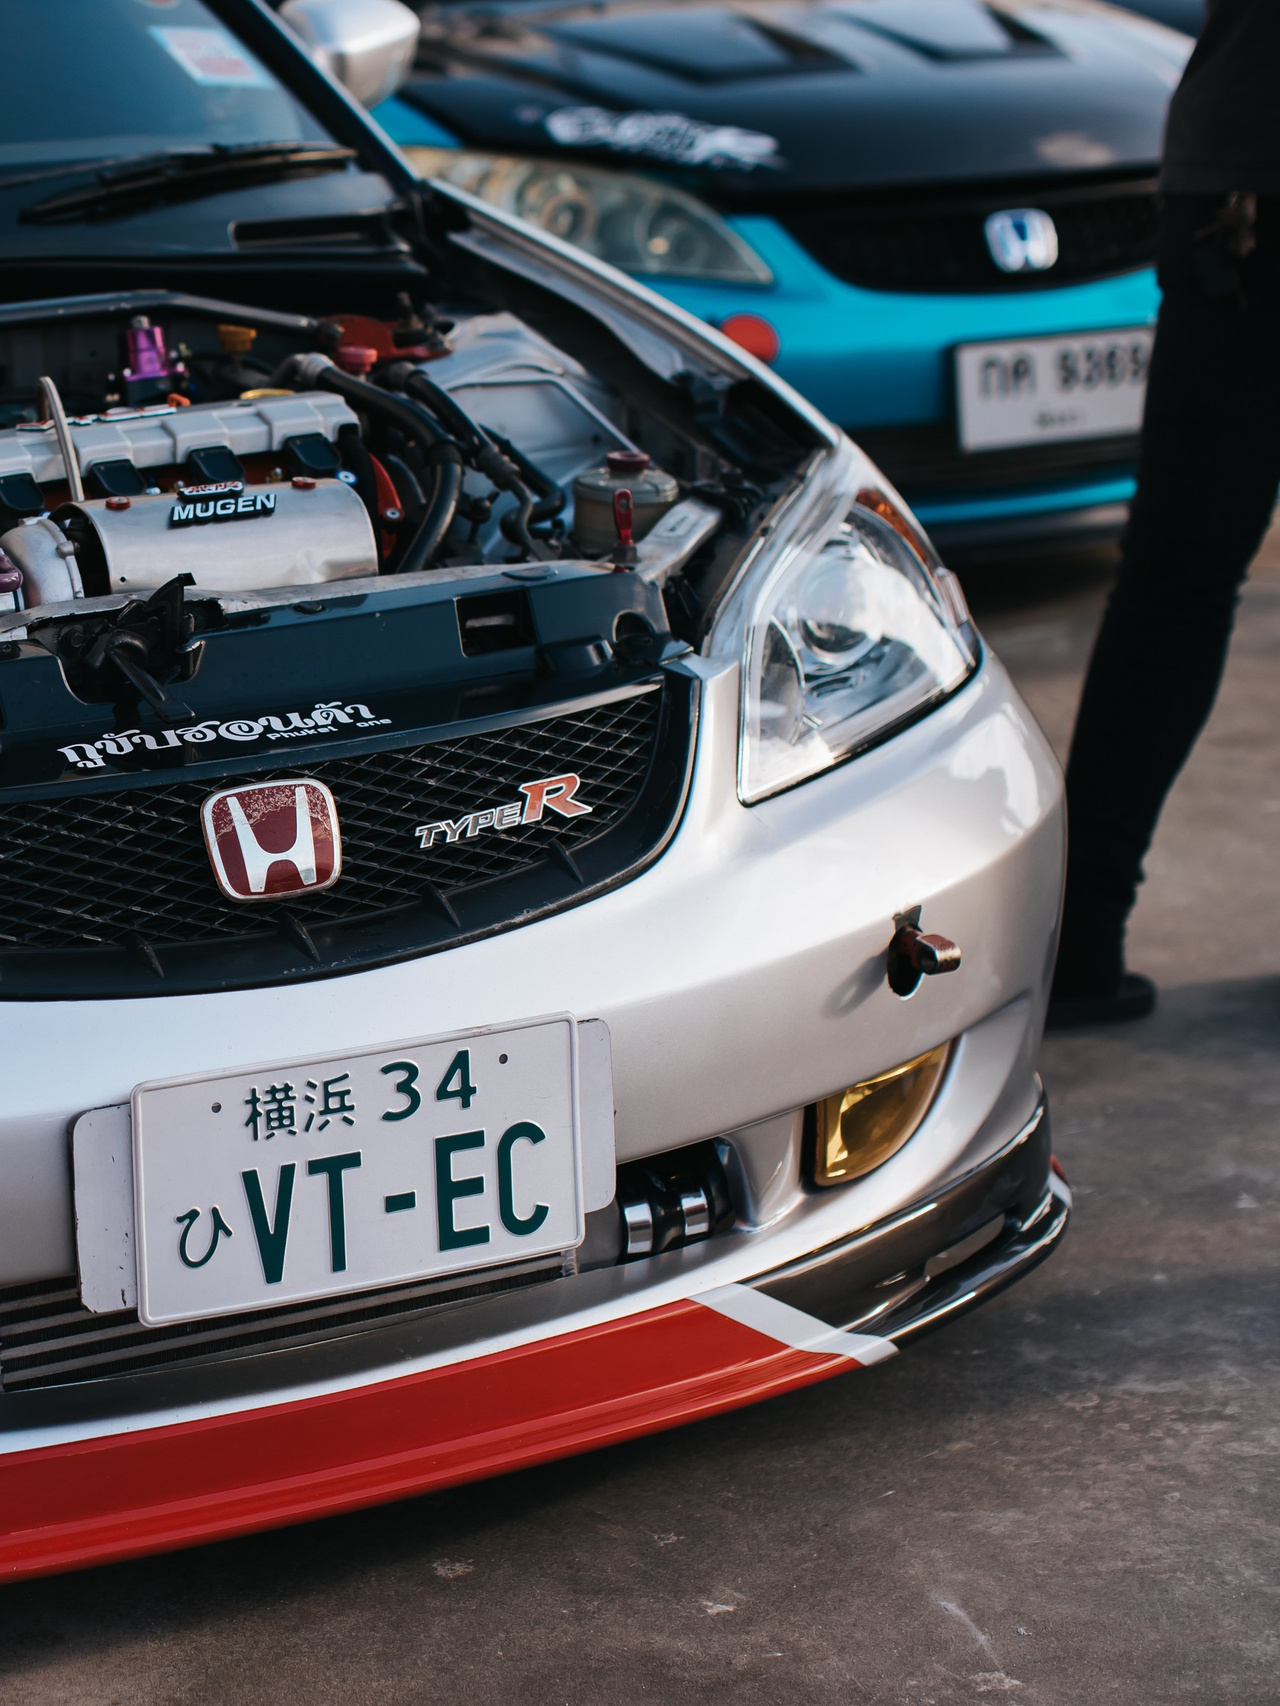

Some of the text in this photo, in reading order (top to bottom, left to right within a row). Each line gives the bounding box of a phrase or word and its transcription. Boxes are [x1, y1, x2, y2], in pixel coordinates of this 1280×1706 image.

[173, 494, 276, 520] MUGEN
[244, 1047, 478, 1141] 横浜 34
[175, 1206, 233, 1268] ひ
